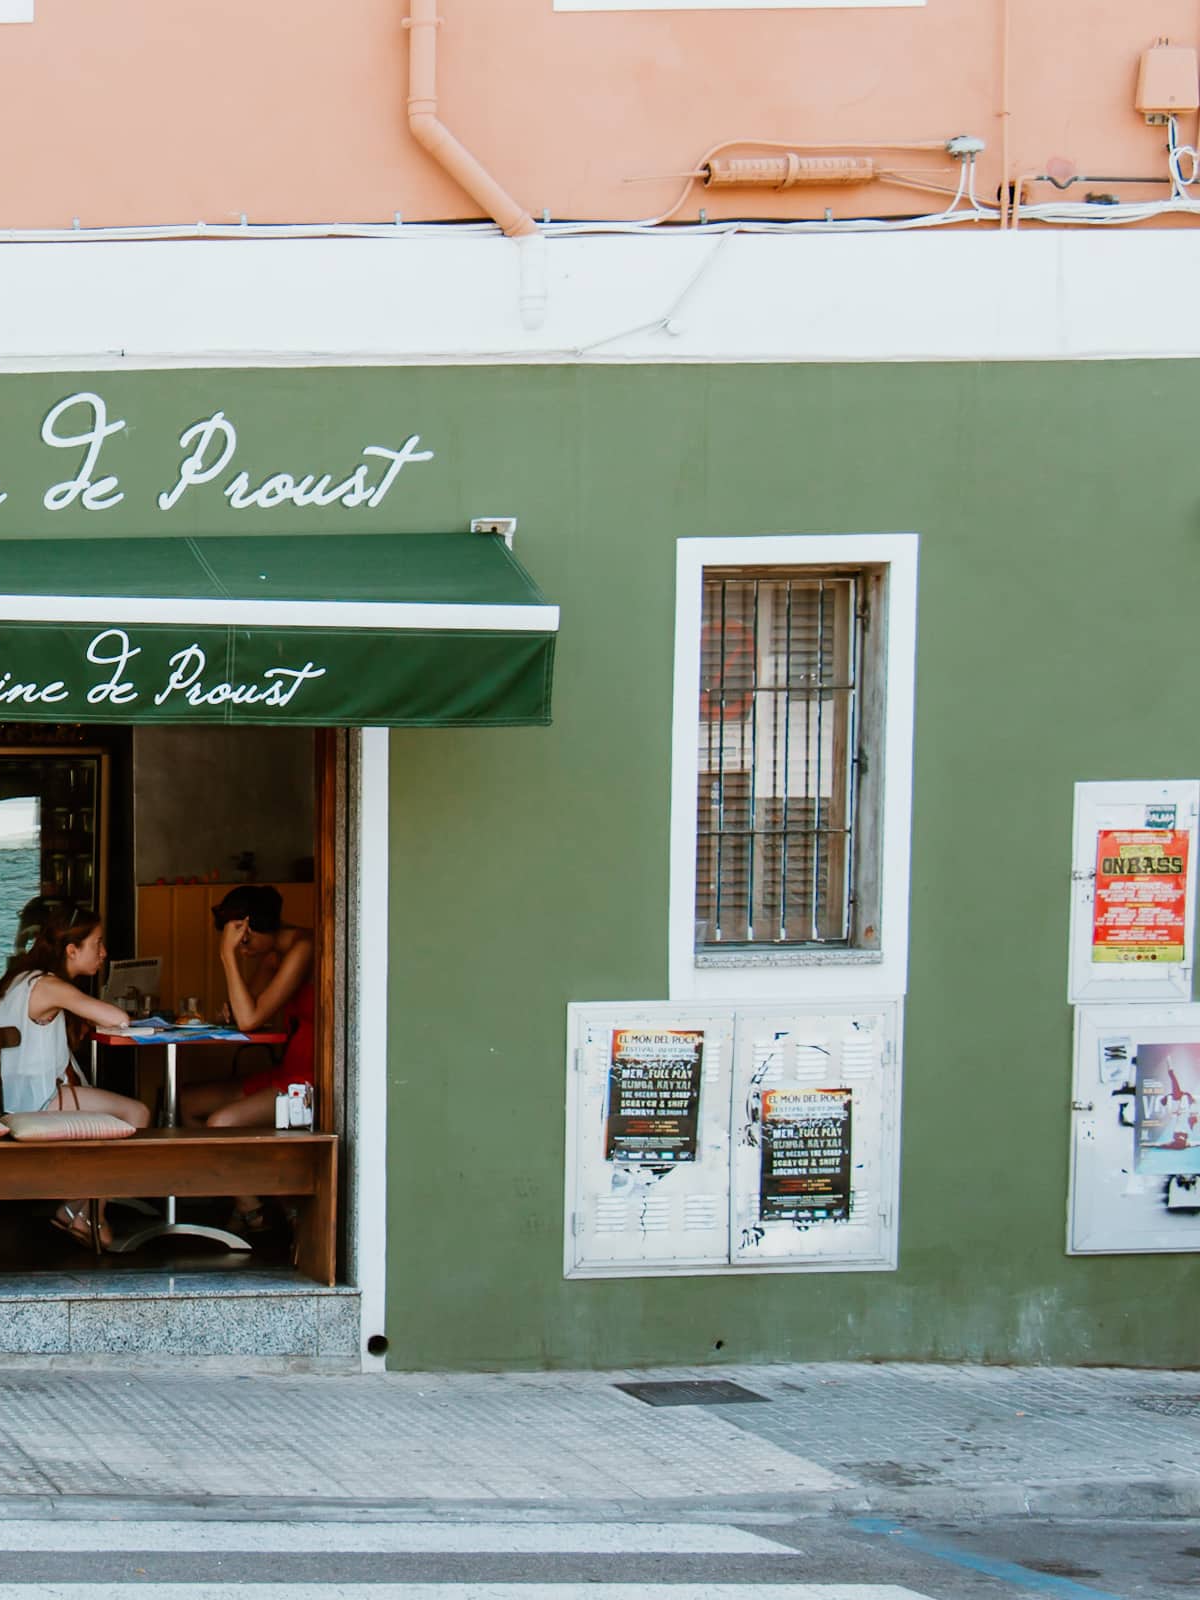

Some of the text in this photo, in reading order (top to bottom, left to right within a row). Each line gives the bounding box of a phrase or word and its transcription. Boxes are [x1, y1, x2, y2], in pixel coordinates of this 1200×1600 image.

[158, 410, 435, 510] Proust
[154, 643, 327, 707] Proust
[619, 1035, 628, 1044] EL
[654, 1035, 669, 1044] DEL
[649, 1069, 670, 1079] FULL
[672, 1069, 693, 1079] PLAY
[621, 1080, 654, 1090] RUMBA
[768, 1095, 778, 1104] EL
[803, 1094, 818, 1103] DEL
[799, 1128, 819, 1138] FULL
[822, 1128, 843, 1138] PLAY
